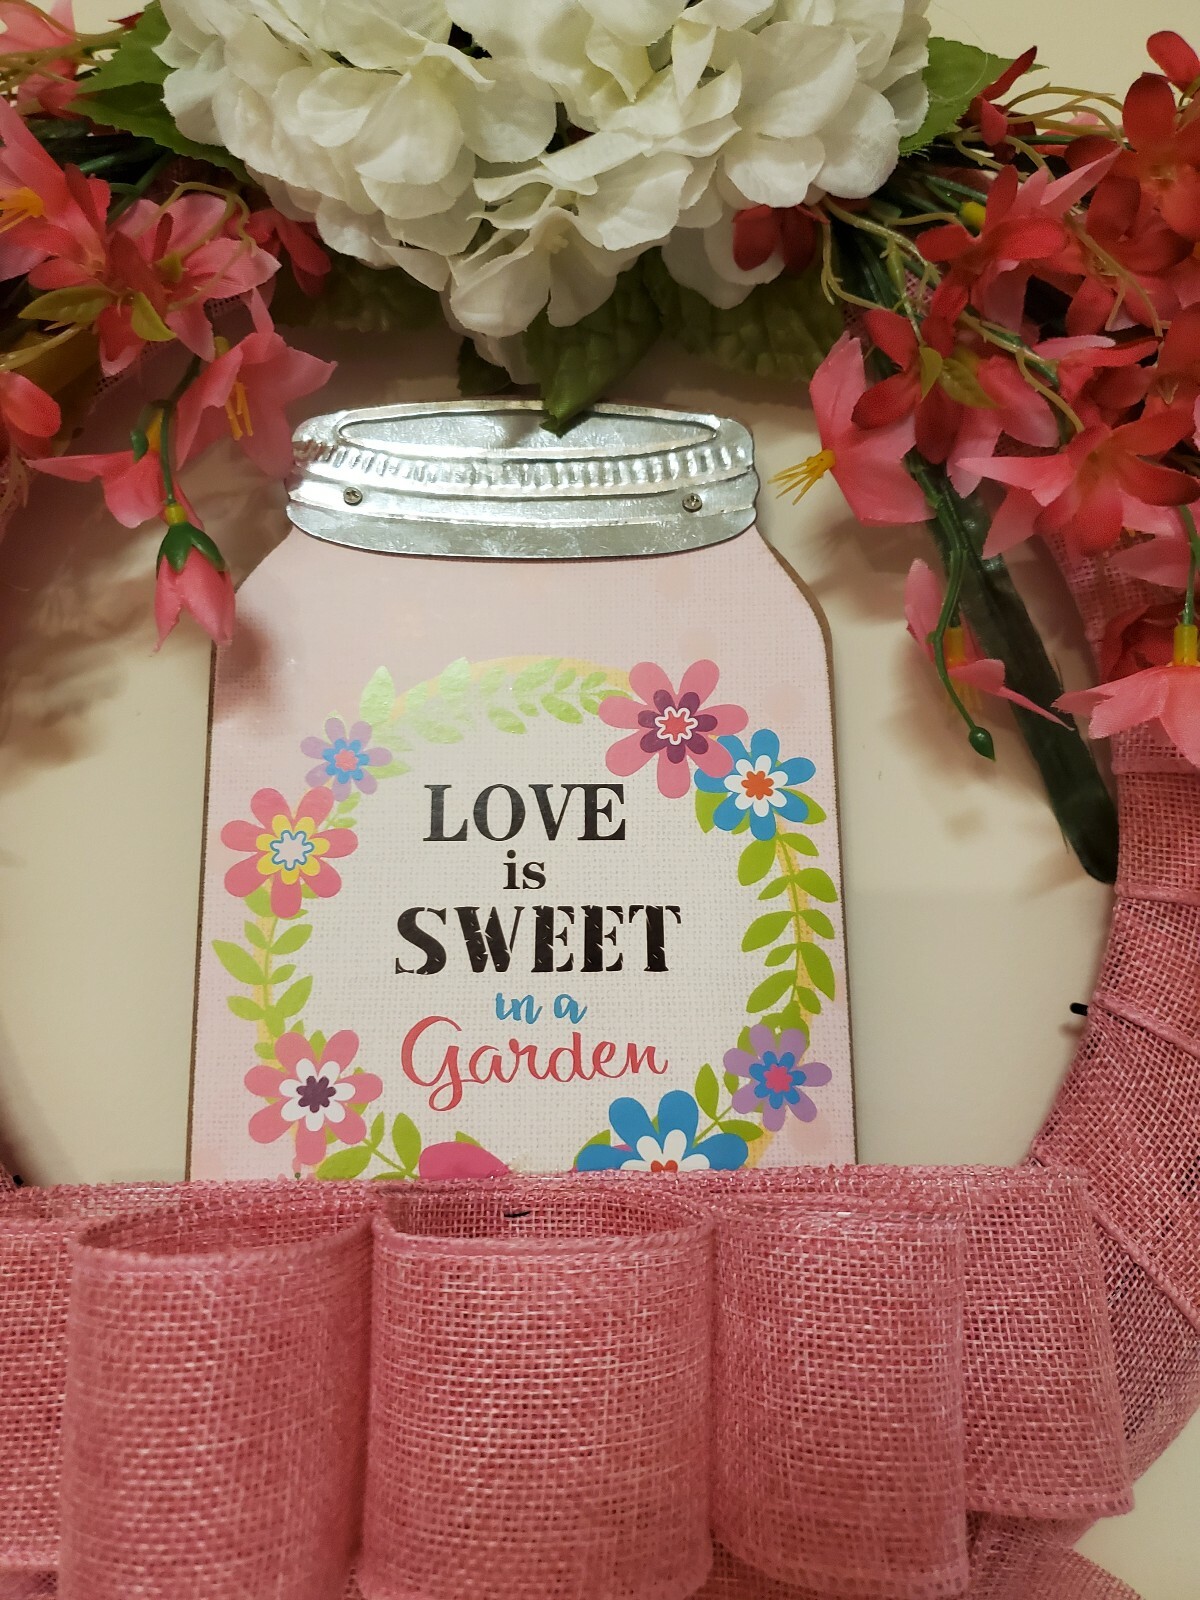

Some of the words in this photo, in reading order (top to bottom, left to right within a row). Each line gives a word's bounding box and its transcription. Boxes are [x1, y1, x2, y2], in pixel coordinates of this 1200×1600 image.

[423, 784, 626, 841] LOVE
[503, 850, 546, 889] is
[395, 905, 682, 975] SWEET
[495, 992, 543, 1024] in
[554, 994, 587, 1024] a
[401, 1015, 668, 1112] Garden
